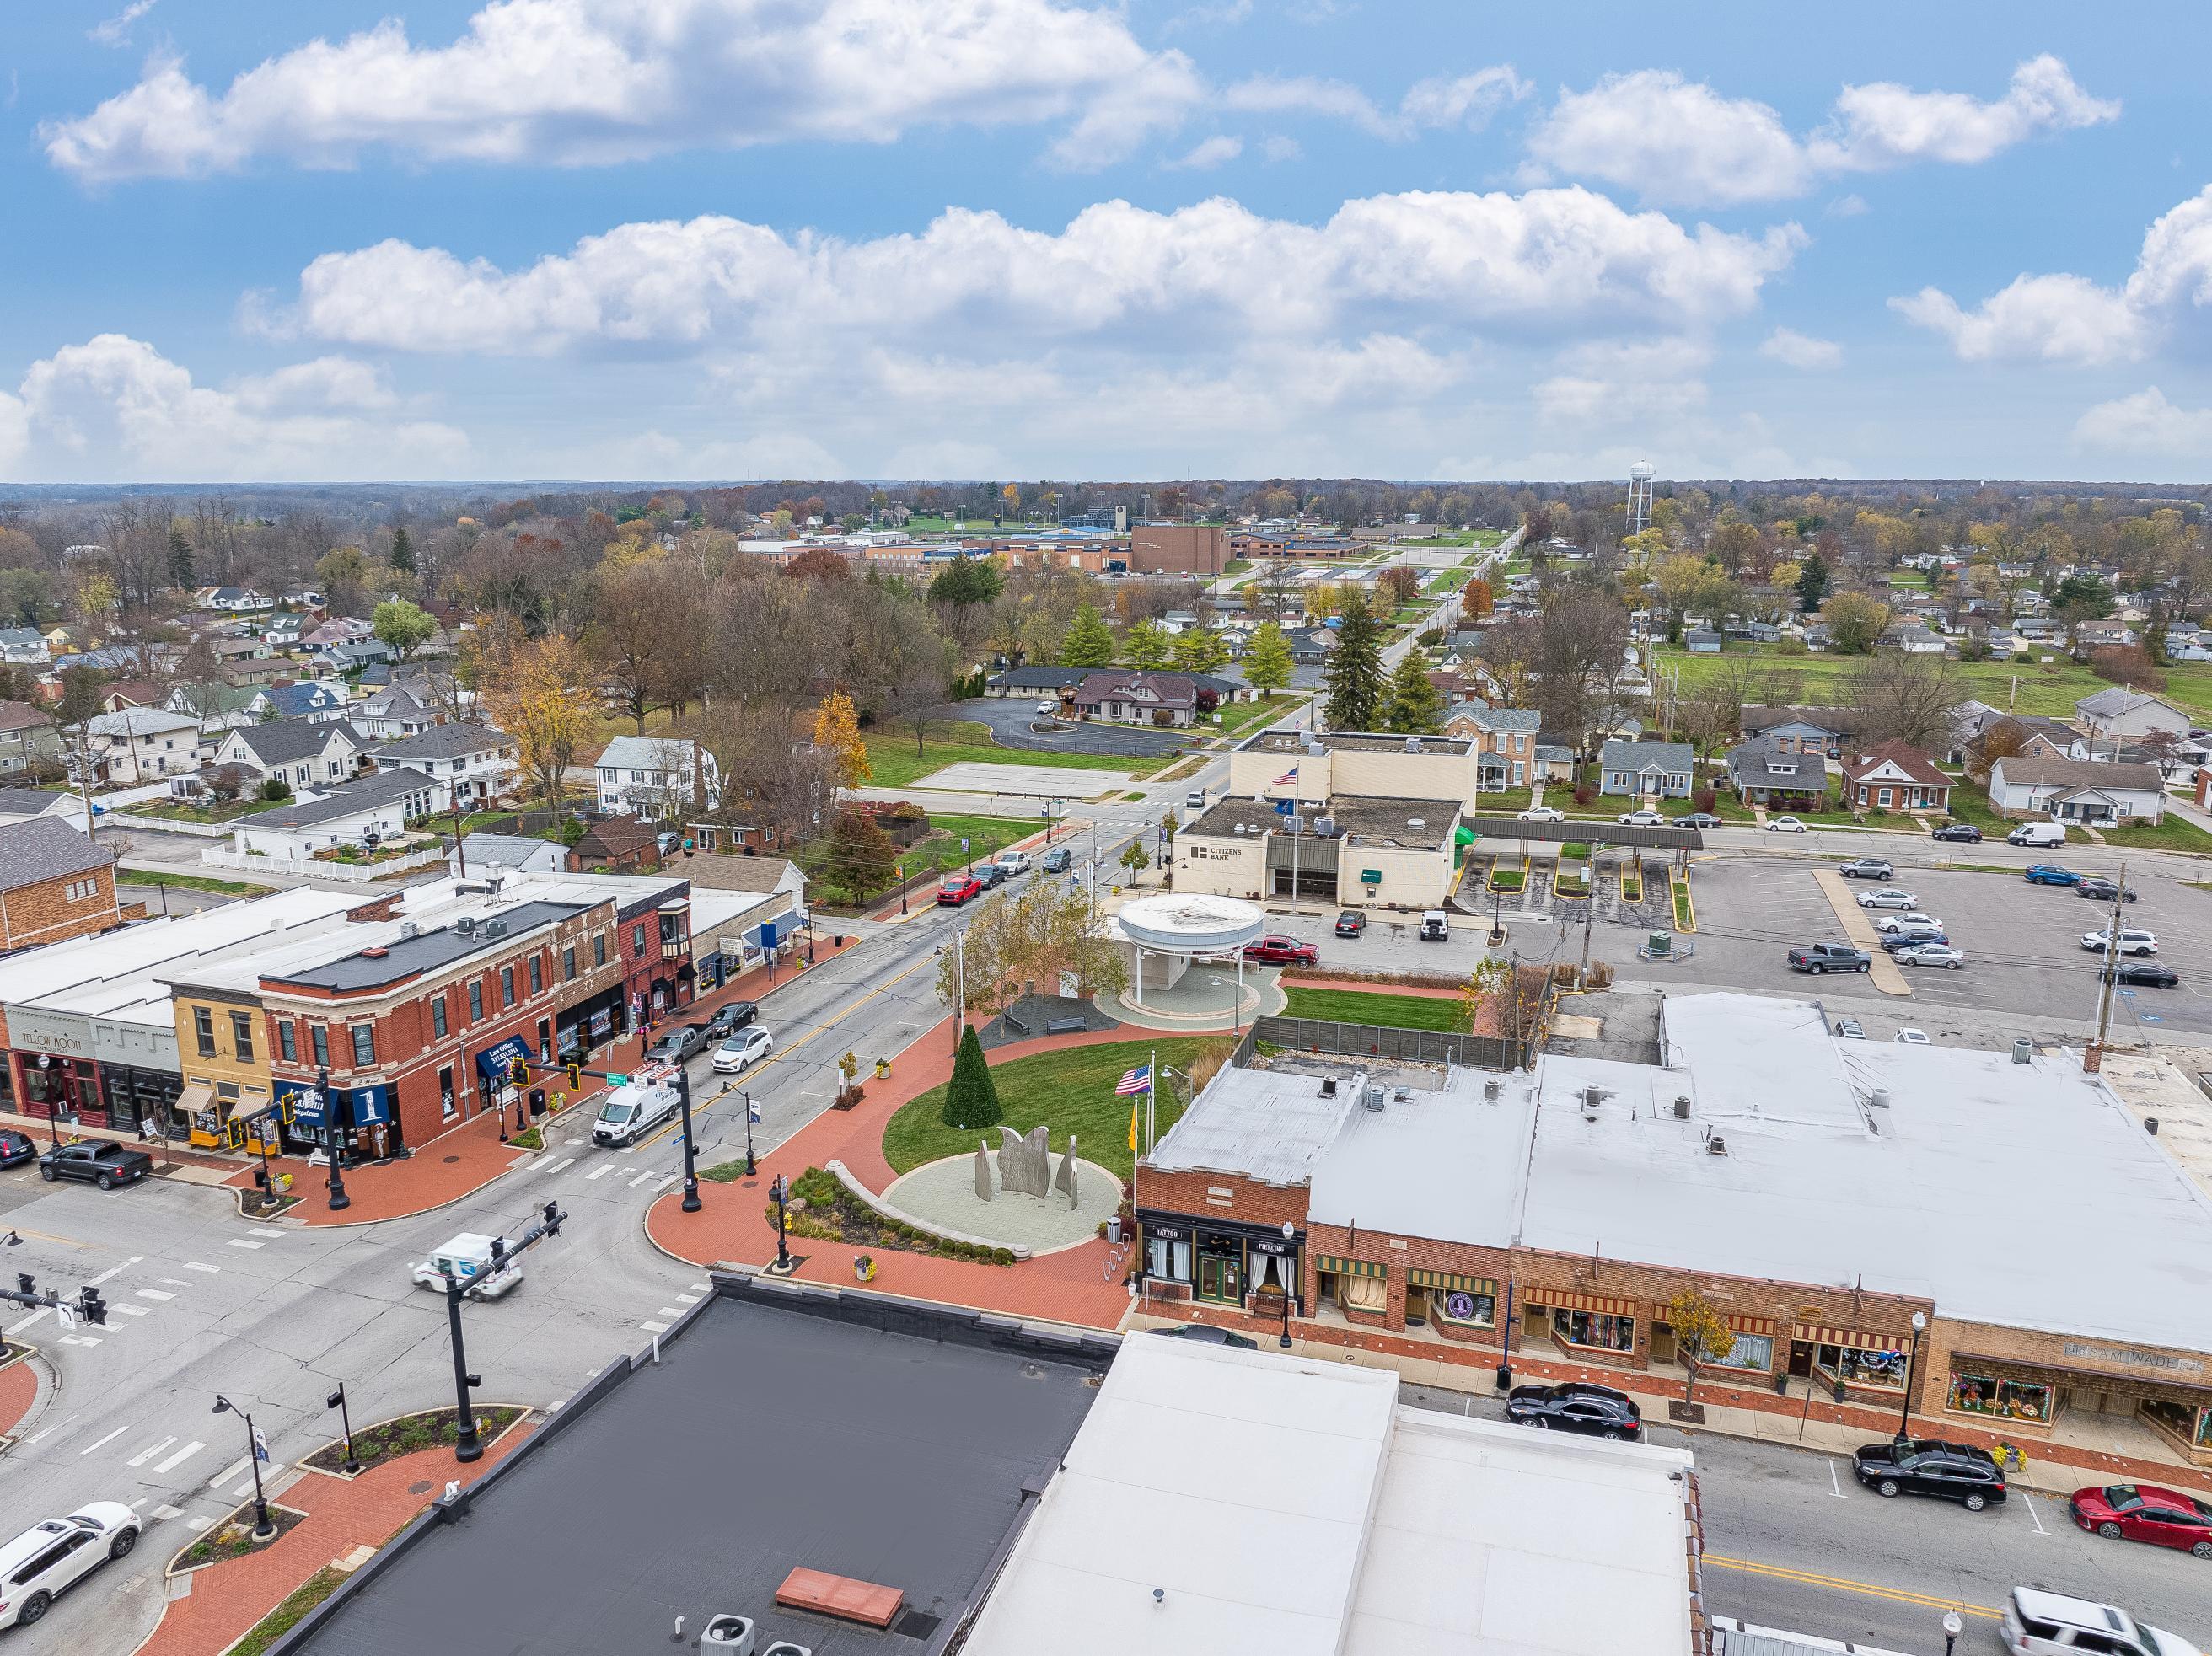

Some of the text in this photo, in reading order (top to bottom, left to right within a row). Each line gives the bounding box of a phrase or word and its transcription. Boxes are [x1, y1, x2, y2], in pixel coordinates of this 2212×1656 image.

[22, 1033, 82, 1050] YELLOW MOON
[488, 1042, 514, 1058] Law Office
[1156, 1228, 1178, 1238] TATTOO
[1258, 1243, 1285, 1253] PIERCING
[1751, 1337, 1765, 1345] Yoga
[2064, 1346, 2203, 1372] 1913 SAM WADE 1925
